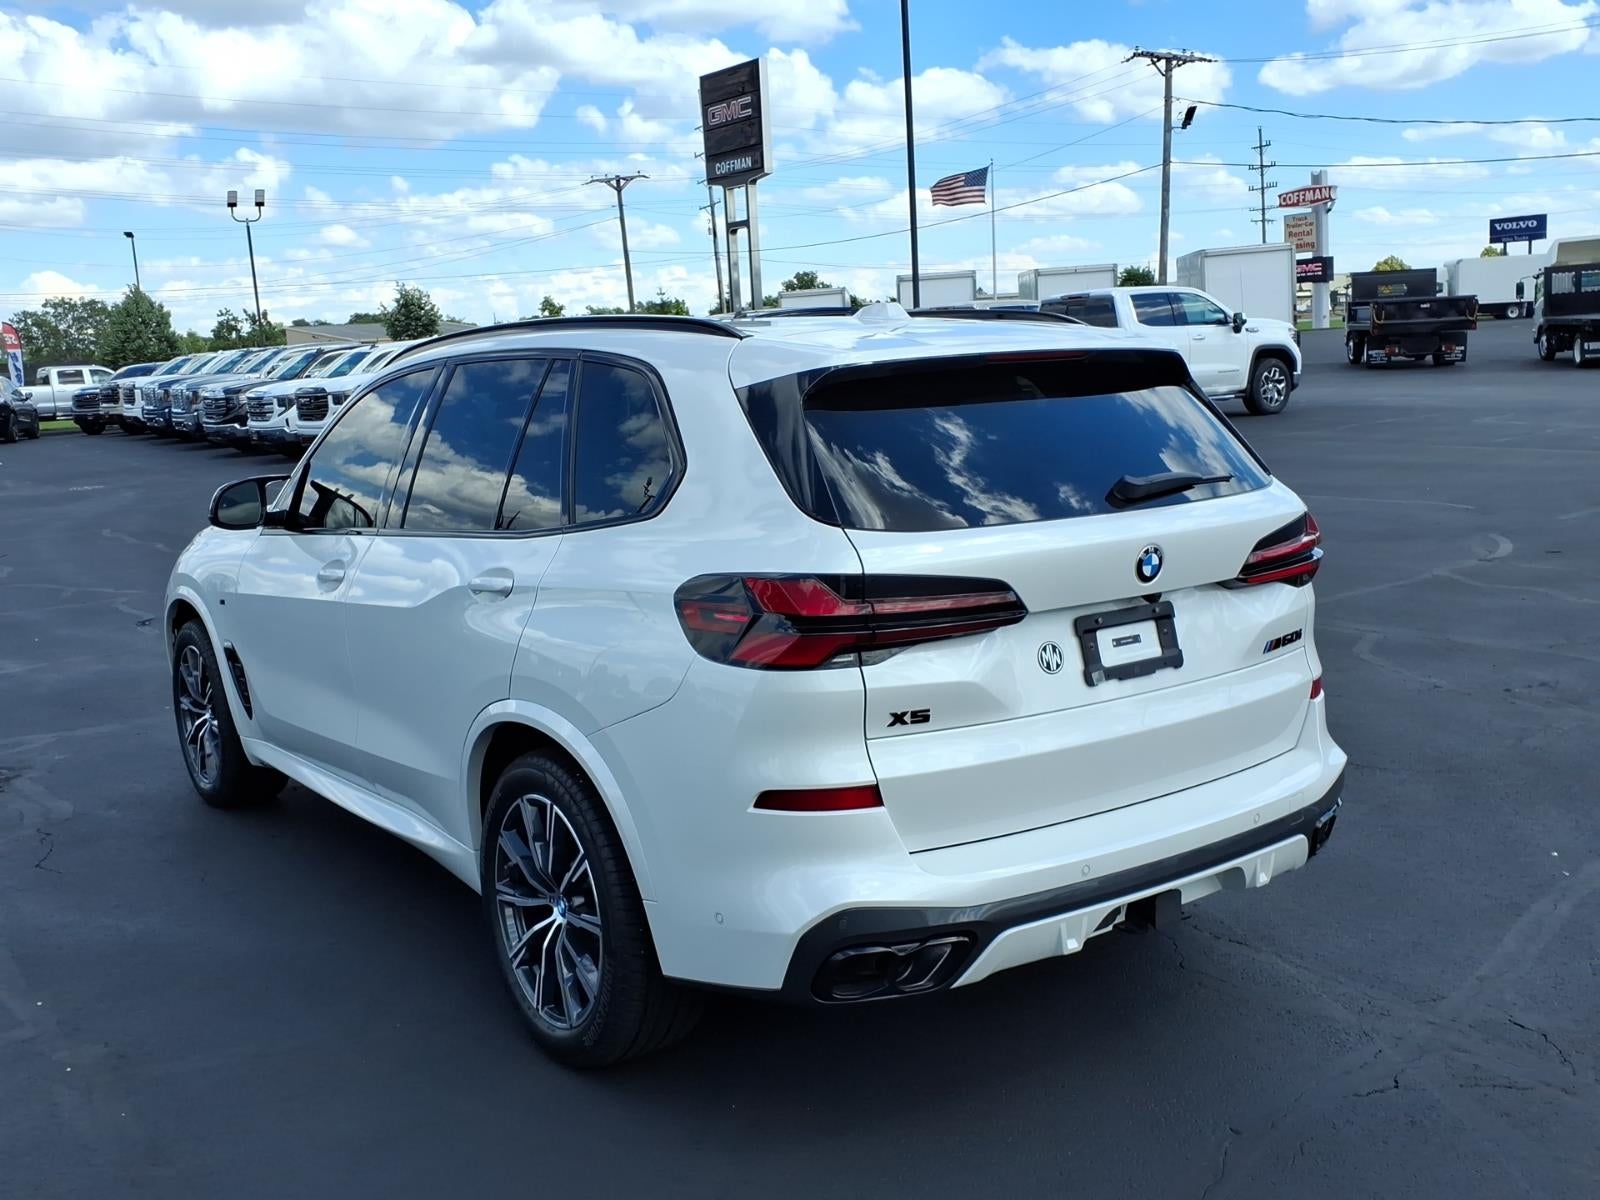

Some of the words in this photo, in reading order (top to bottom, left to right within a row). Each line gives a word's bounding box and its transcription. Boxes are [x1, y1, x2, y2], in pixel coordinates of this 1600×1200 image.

[707, 96, 752, 126] GMC
[715, 157, 752, 175] COFFMAN
[1281, 188, 1329, 205] COFFMAN
[1494, 220, 1537, 230] VOLVO
[1288, 229, 1313, 239] Rental
[1296, 263, 1322, 272] GMC
[887, 708, 931, 728] X5
